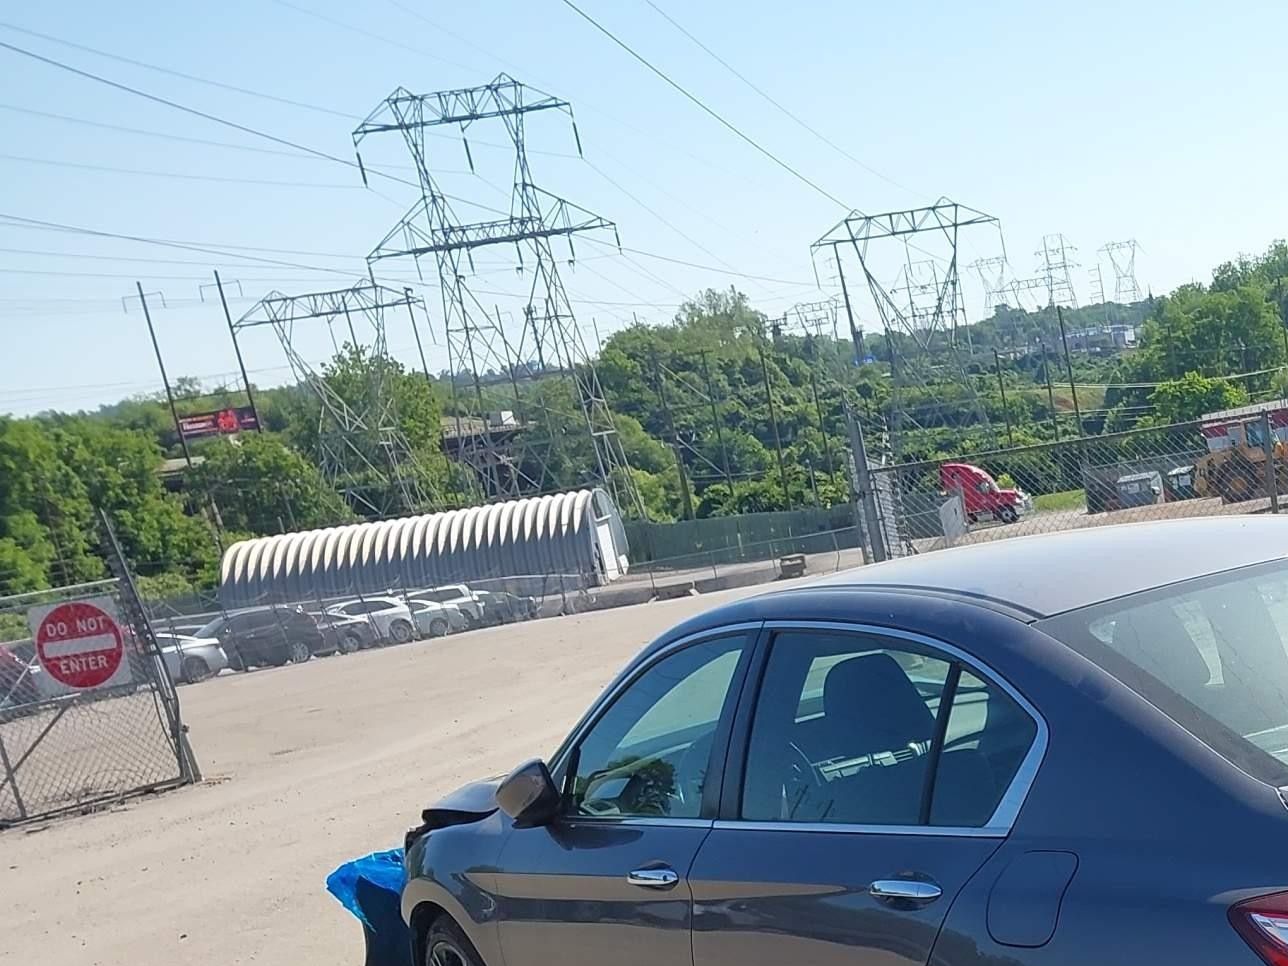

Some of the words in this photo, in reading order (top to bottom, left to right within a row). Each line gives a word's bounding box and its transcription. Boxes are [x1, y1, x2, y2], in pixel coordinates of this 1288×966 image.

[46, 622, 68, 637] DO
[76, 615, 106, 633] NOT
[60, 655, 109, 674] ENTER
